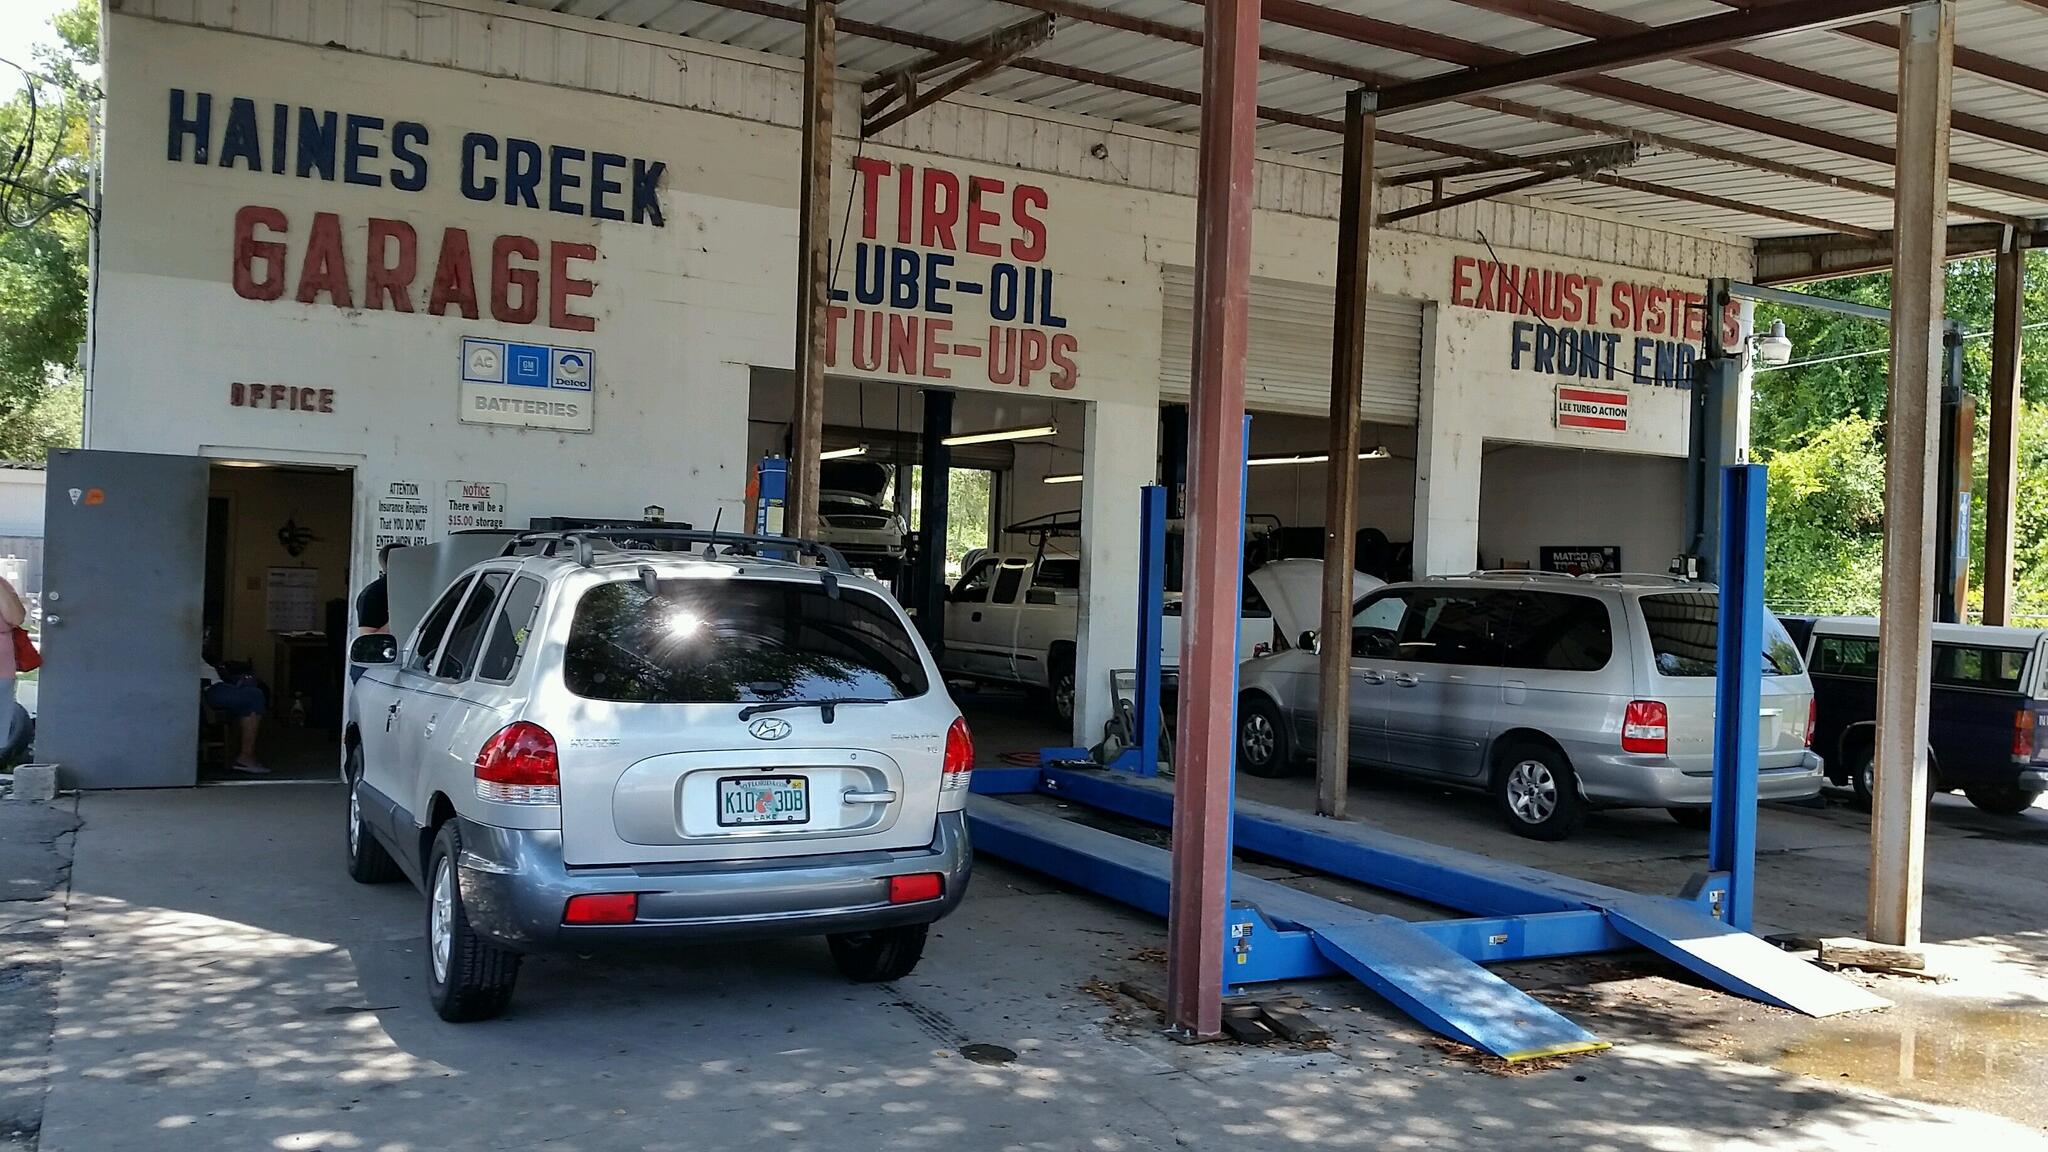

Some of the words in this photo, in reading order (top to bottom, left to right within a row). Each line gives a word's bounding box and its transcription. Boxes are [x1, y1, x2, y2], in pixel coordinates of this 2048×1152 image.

[167, 88, 429, 193] HAINES
[460, 131, 667, 228] CREEK
[853, 155, 1049, 263] TIRES
[232, 205, 597, 332] GARAGE
[826, 238, 1067, 329] LUBE-OIL
[1452, 255, 1603, 325] EXHAUST
[1610, 280, 1741, 346] SYSTES
[825, 306, 1079, 391] TUNE-UPS
[1511, 320, 1621, 381] FRONT
[1633, 336, 1696, 390] END
[473, 353, 495, 369] AC
[522, 360, 535, 370] GM
[555, 377, 588, 388] Delco
[230, 382, 334, 414] OFFICE
[474, 395, 579, 418] BATTERIES
[1559, 402, 1572, 412] LEE
[1572, 403, 1598, 415] TURBO
[1598, 406, 1628, 418] ACTION
[390, 482, 420, 496] ATTENTION
[462, 485, 491, 497] NOTICE
[379, 500, 404, 513] Insurance
[405, 501, 428, 516] Requires
[448, 499, 470, 512] There
[472, 501, 485, 512] will
[487, 502, 497, 512] be
[498, 504, 504, 513] a
[380, 517, 392, 530] That
[393, 518, 404, 530] YOU
[405, 518, 414, 531] DO
[415, 519, 427, 531] NOT
[448, 514, 474, 526] $15.00
[475, 517, 503, 530] storage
[1553, 551, 1589, 561] MATCO
[753, 813, 778, 821] LAKE
